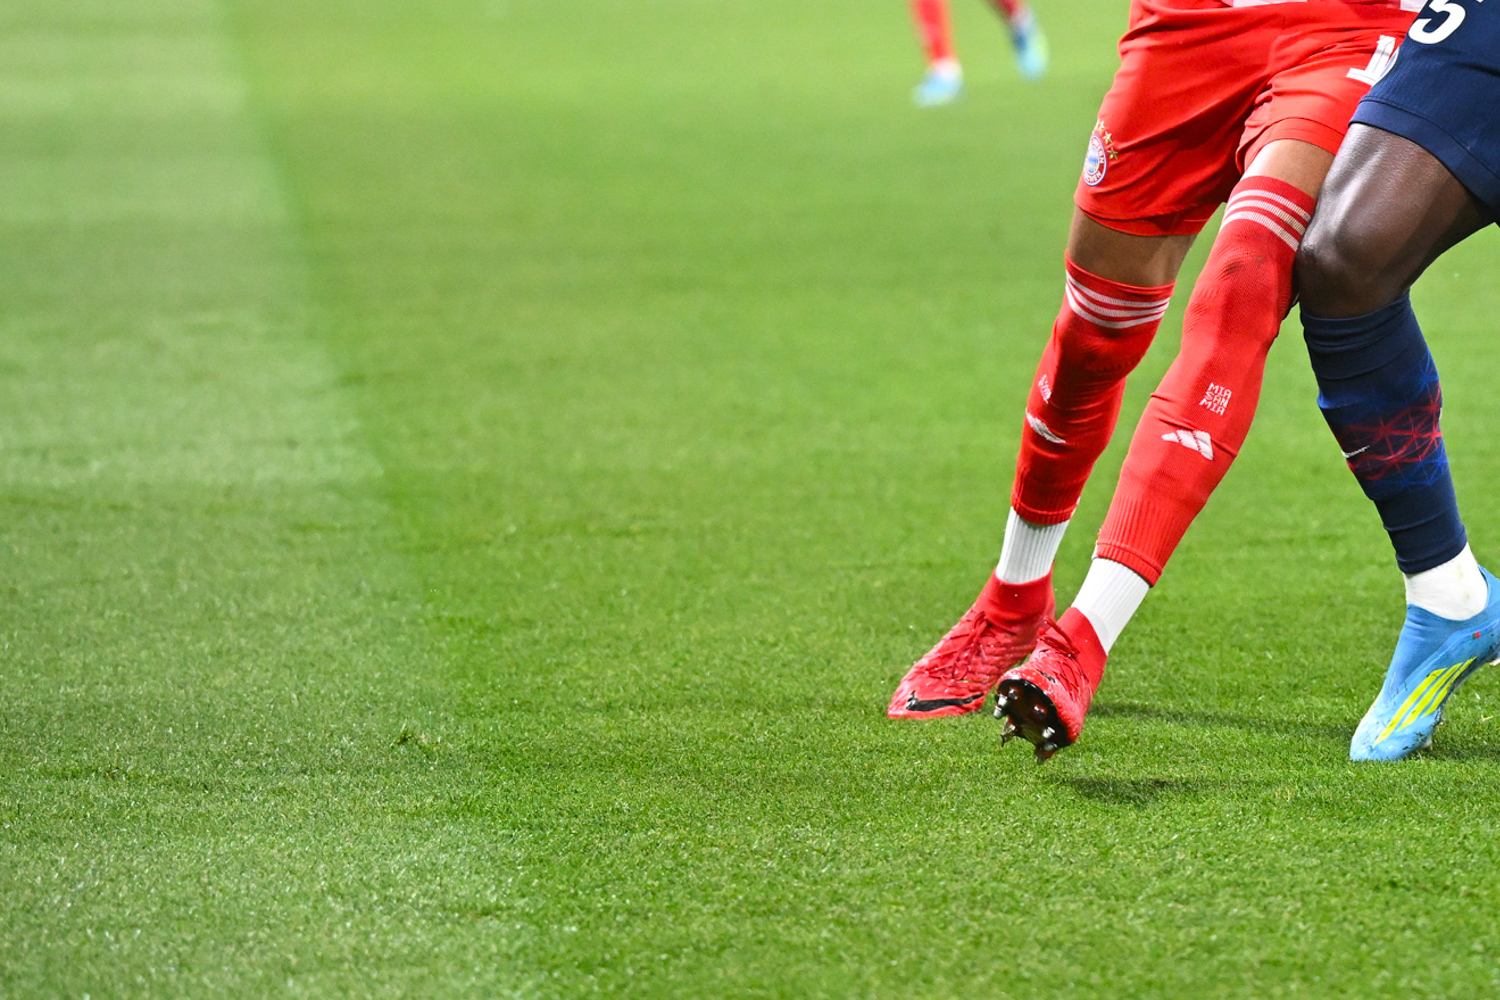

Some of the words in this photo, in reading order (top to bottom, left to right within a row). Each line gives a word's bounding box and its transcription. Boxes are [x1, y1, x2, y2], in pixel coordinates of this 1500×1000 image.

[1207, 382, 1232, 398] MIA
[1199, 398, 1225, 416] MIA
[1205, 391, 1230, 408] SAN
